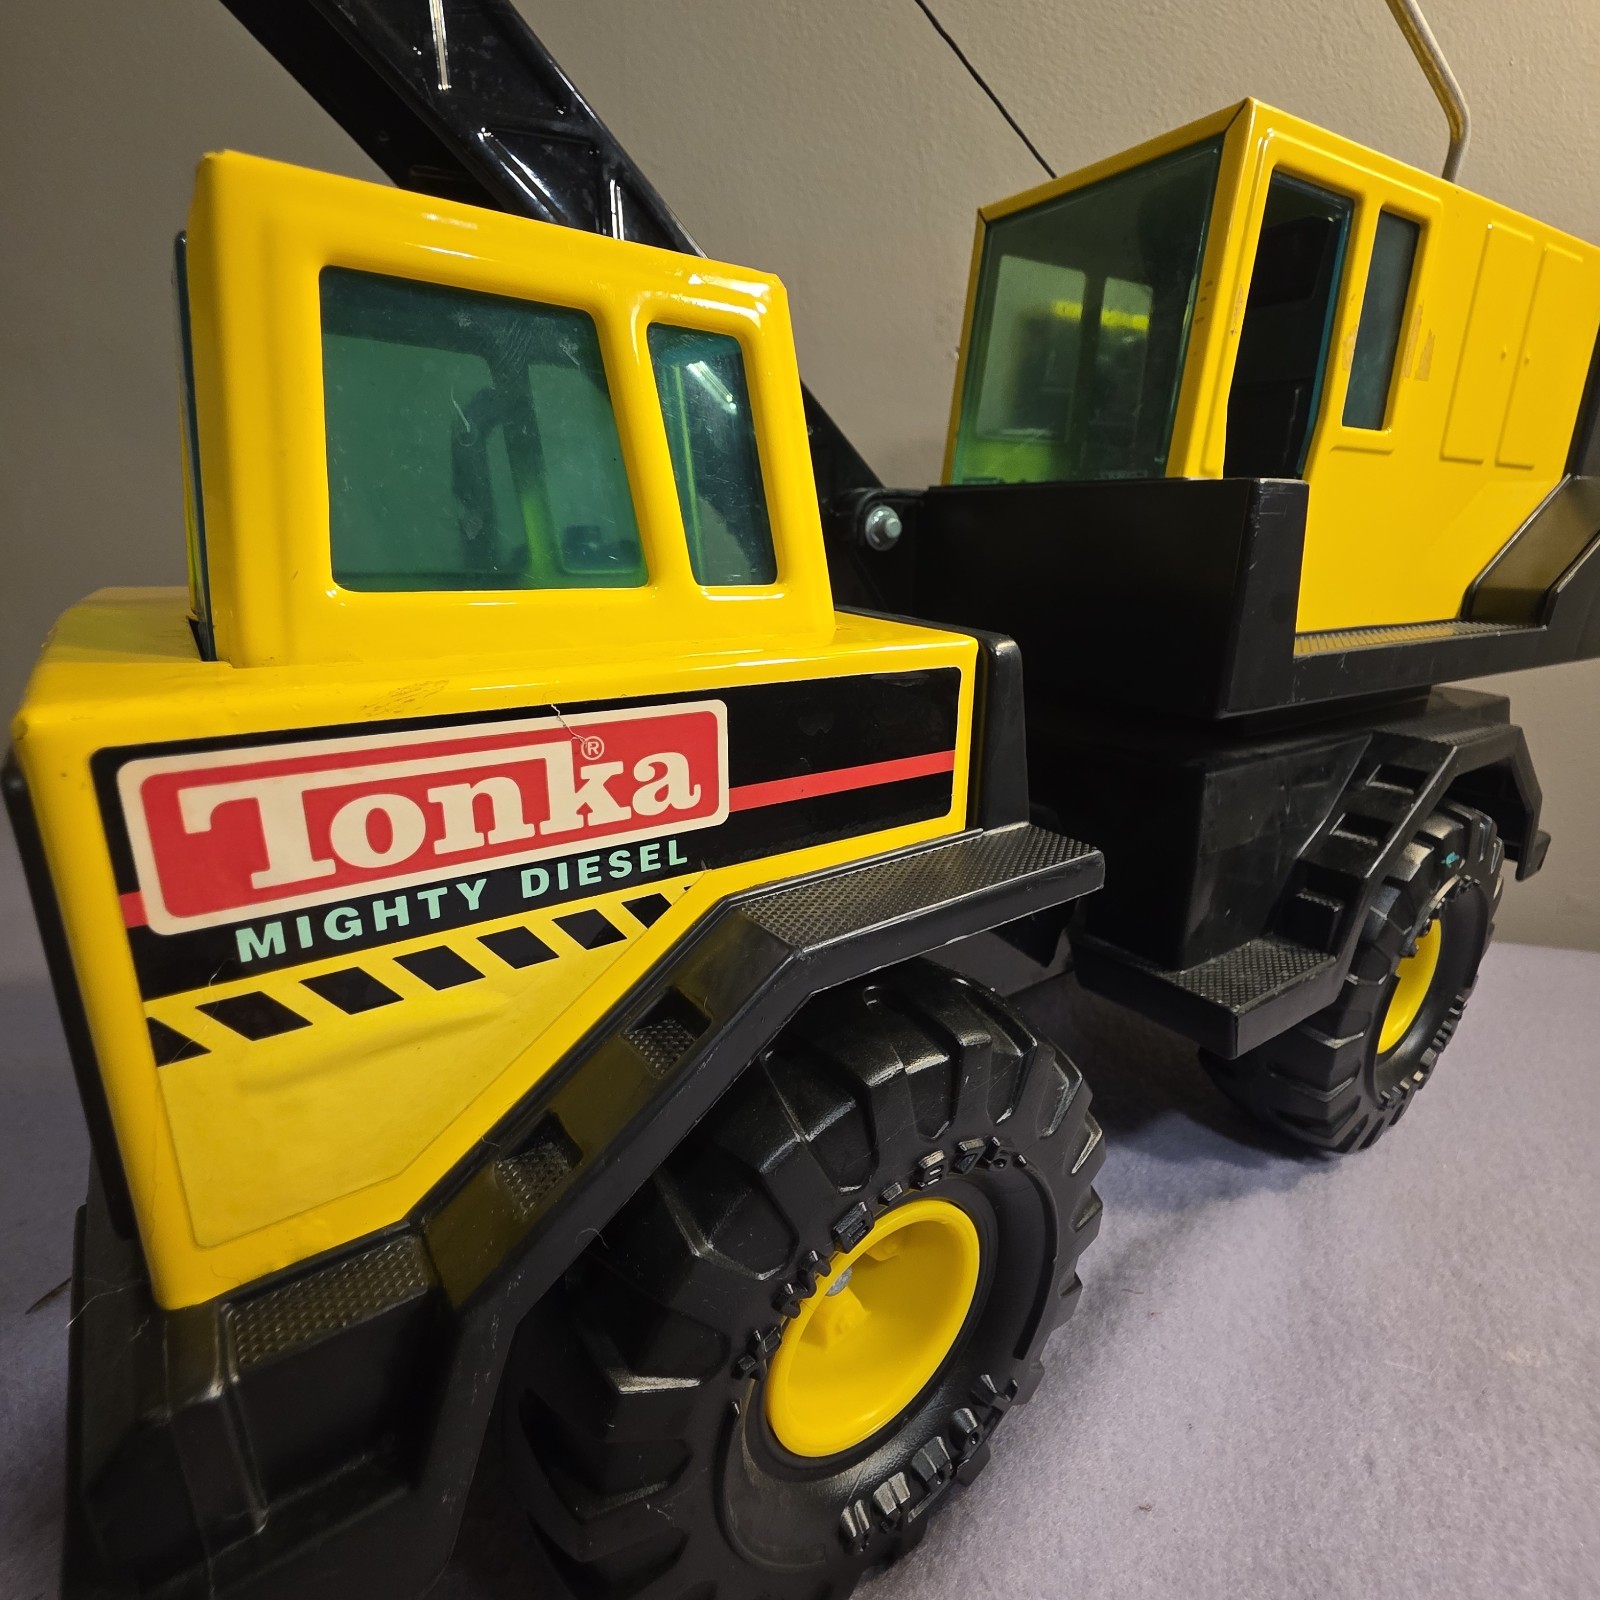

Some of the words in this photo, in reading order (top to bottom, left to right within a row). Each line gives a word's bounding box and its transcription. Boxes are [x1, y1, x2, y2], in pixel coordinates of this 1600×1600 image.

[177, 739, 701, 890] Tonka
[236, 879, 488, 963] MIGHTY
[520, 839, 688, 899] DIESEL
